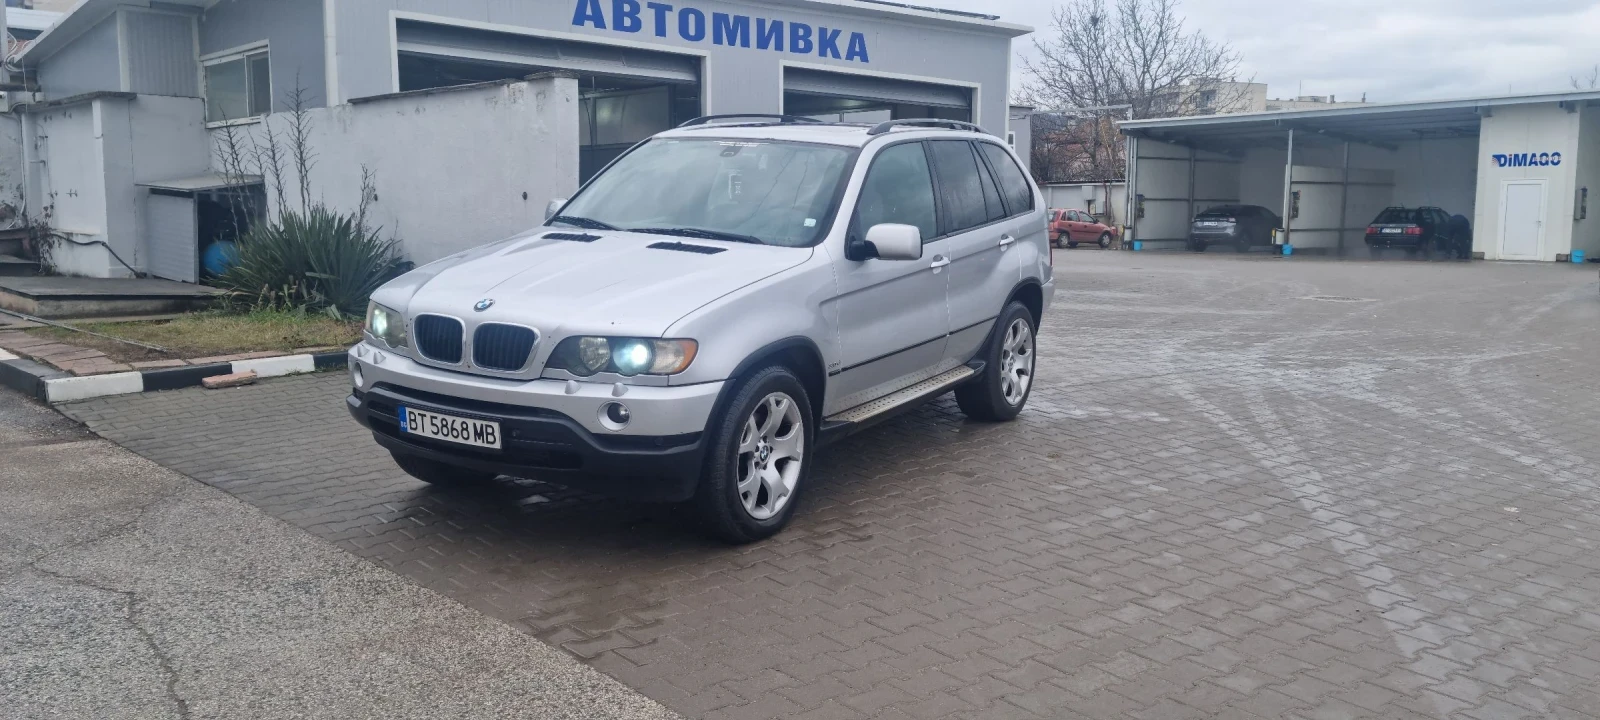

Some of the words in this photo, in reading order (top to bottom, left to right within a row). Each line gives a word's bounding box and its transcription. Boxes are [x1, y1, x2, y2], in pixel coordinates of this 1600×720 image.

[571, 0, 870, 64] АВТОМИВКА
[408, 410, 427, 433] BT
[429, 415, 470, 441] 5868
[472, 422, 497, 445] MB
